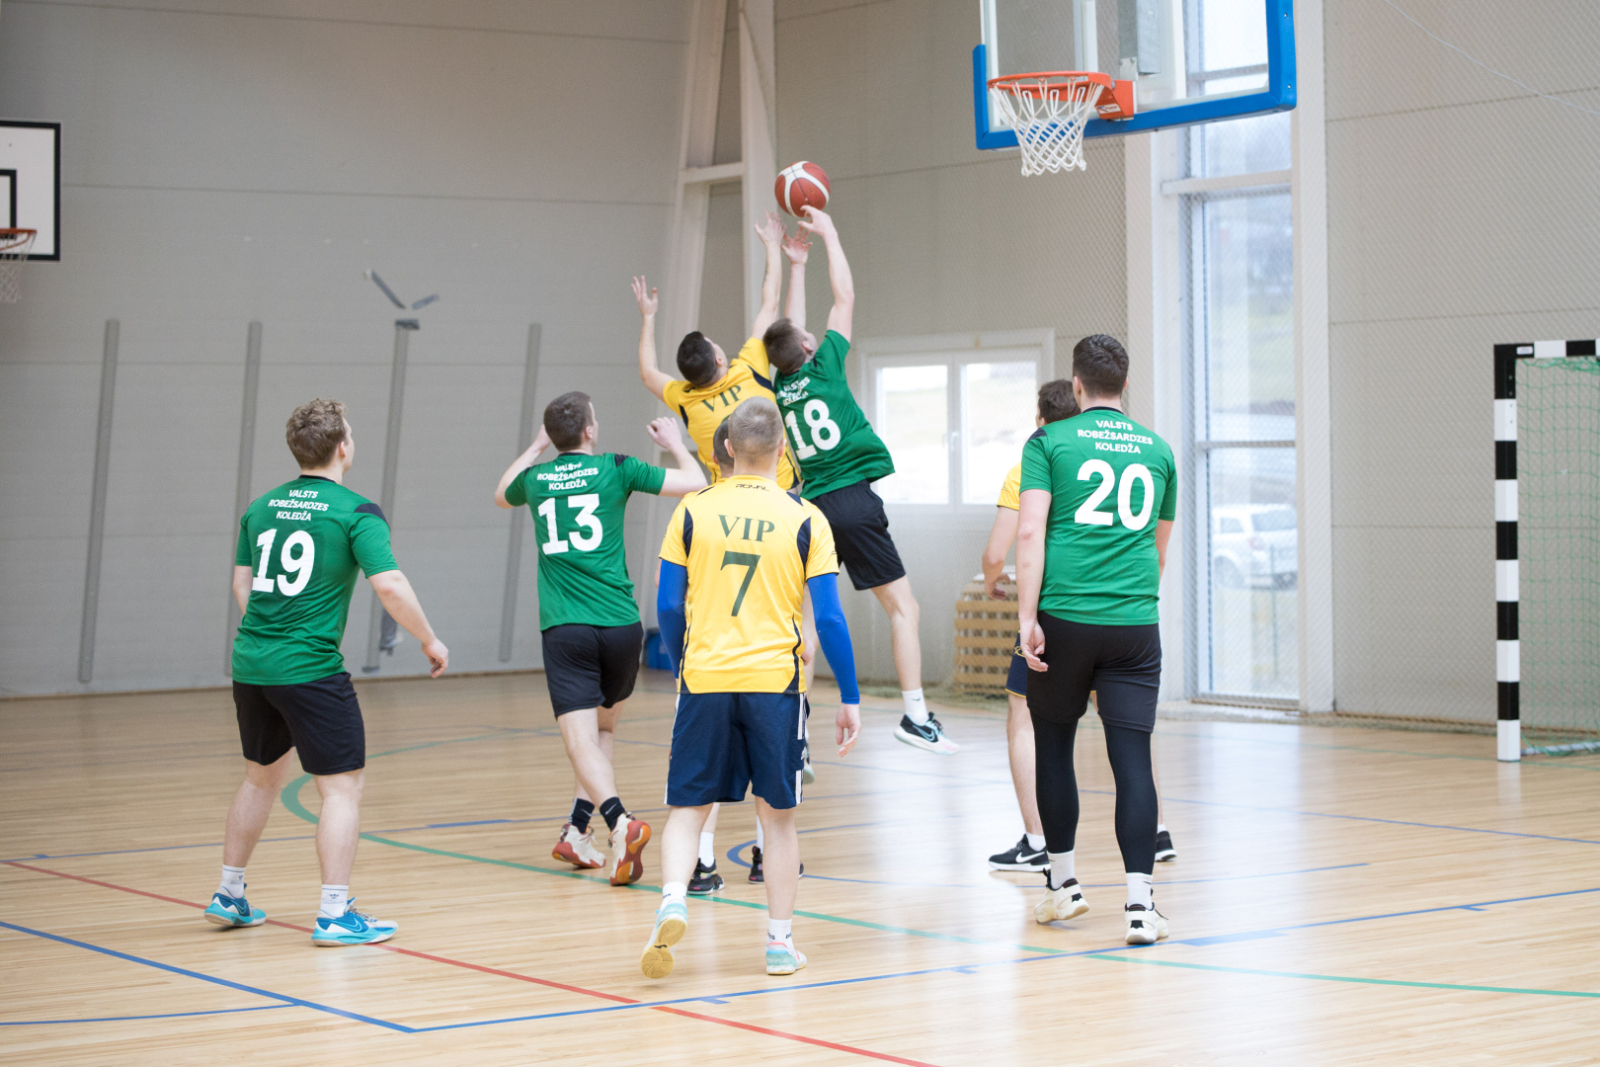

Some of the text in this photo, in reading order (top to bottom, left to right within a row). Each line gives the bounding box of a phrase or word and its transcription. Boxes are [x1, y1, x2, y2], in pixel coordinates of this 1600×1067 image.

[702, 385, 742, 412] VIP
[785, 399, 841, 460] 18
[1095, 420, 1133, 431] VALSTS
[1077, 429, 1153, 445] ROBEŽSARDZES
[1095, 441, 1141, 454] KOLEDŽA
[288, 489, 318, 499] VALSTS
[548, 479, 588, 491] KOLEDŽA
[1074, 459, 1154, 531] 20
[268, 499, 329, 511] ROBEŽSARDZES
[276, 510, 311, 521] KOLEDŽA
[537, 493, 603, 555] 13
[717, 514, 775, 543] VIP
[251, 528, 315, 597] 19
[720, 550, 761, 617] 7
